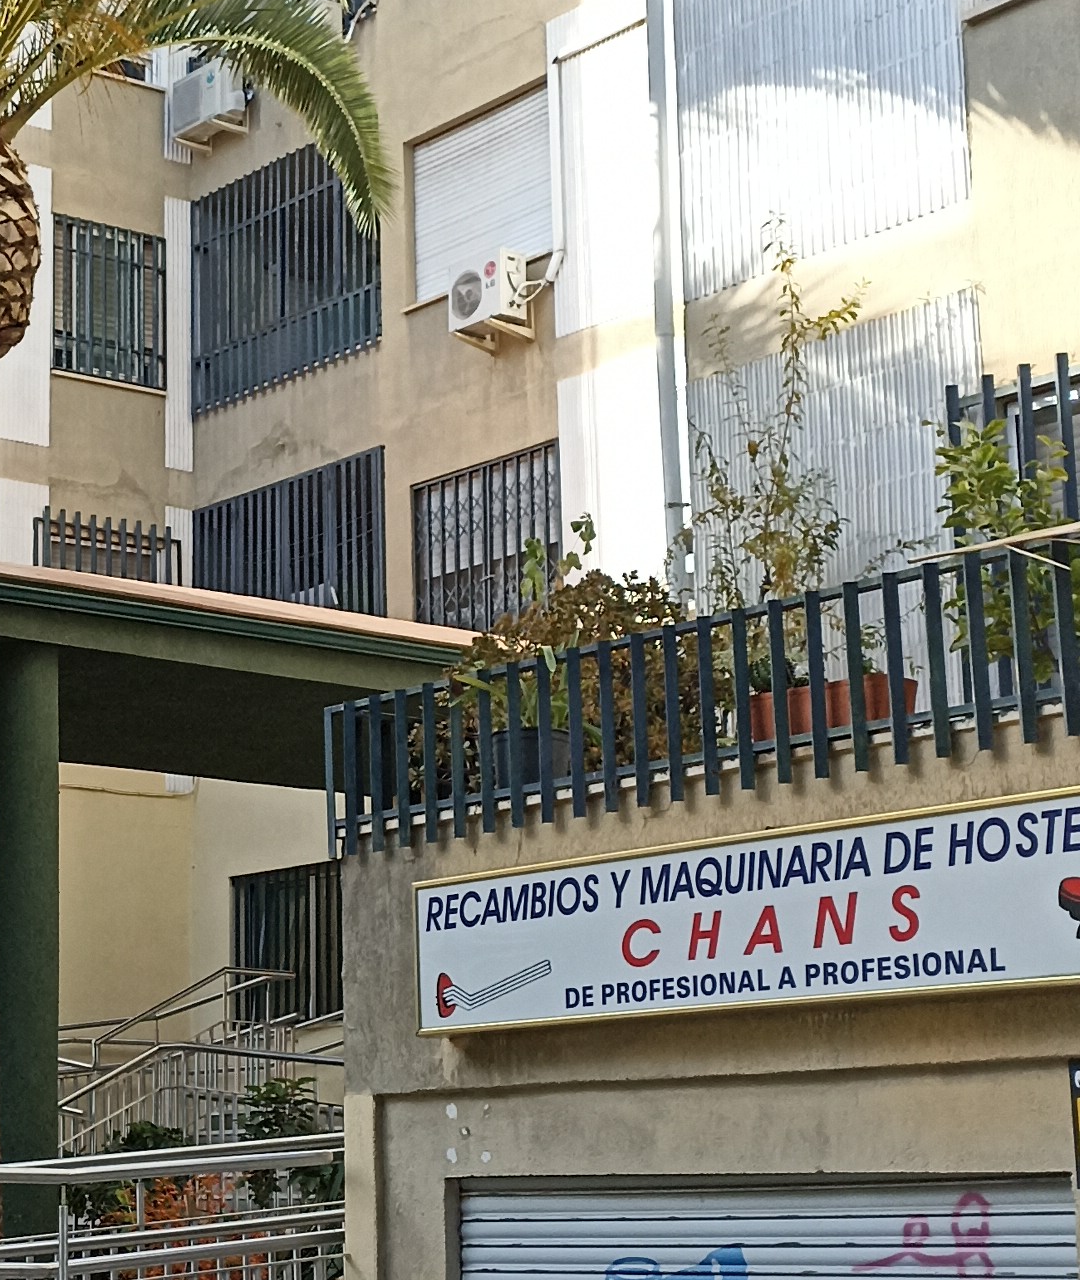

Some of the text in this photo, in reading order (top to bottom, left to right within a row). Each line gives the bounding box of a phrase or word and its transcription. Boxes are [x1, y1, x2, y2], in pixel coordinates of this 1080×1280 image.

[426, 806, 1080, 932] RECAMBIOS Y MAQUINARIA DE HOSTE
[622, 885, 921, 968] CHANS
[565, 947, 1006, 1009] DE PROFESIONAL A PROFESIONAL
